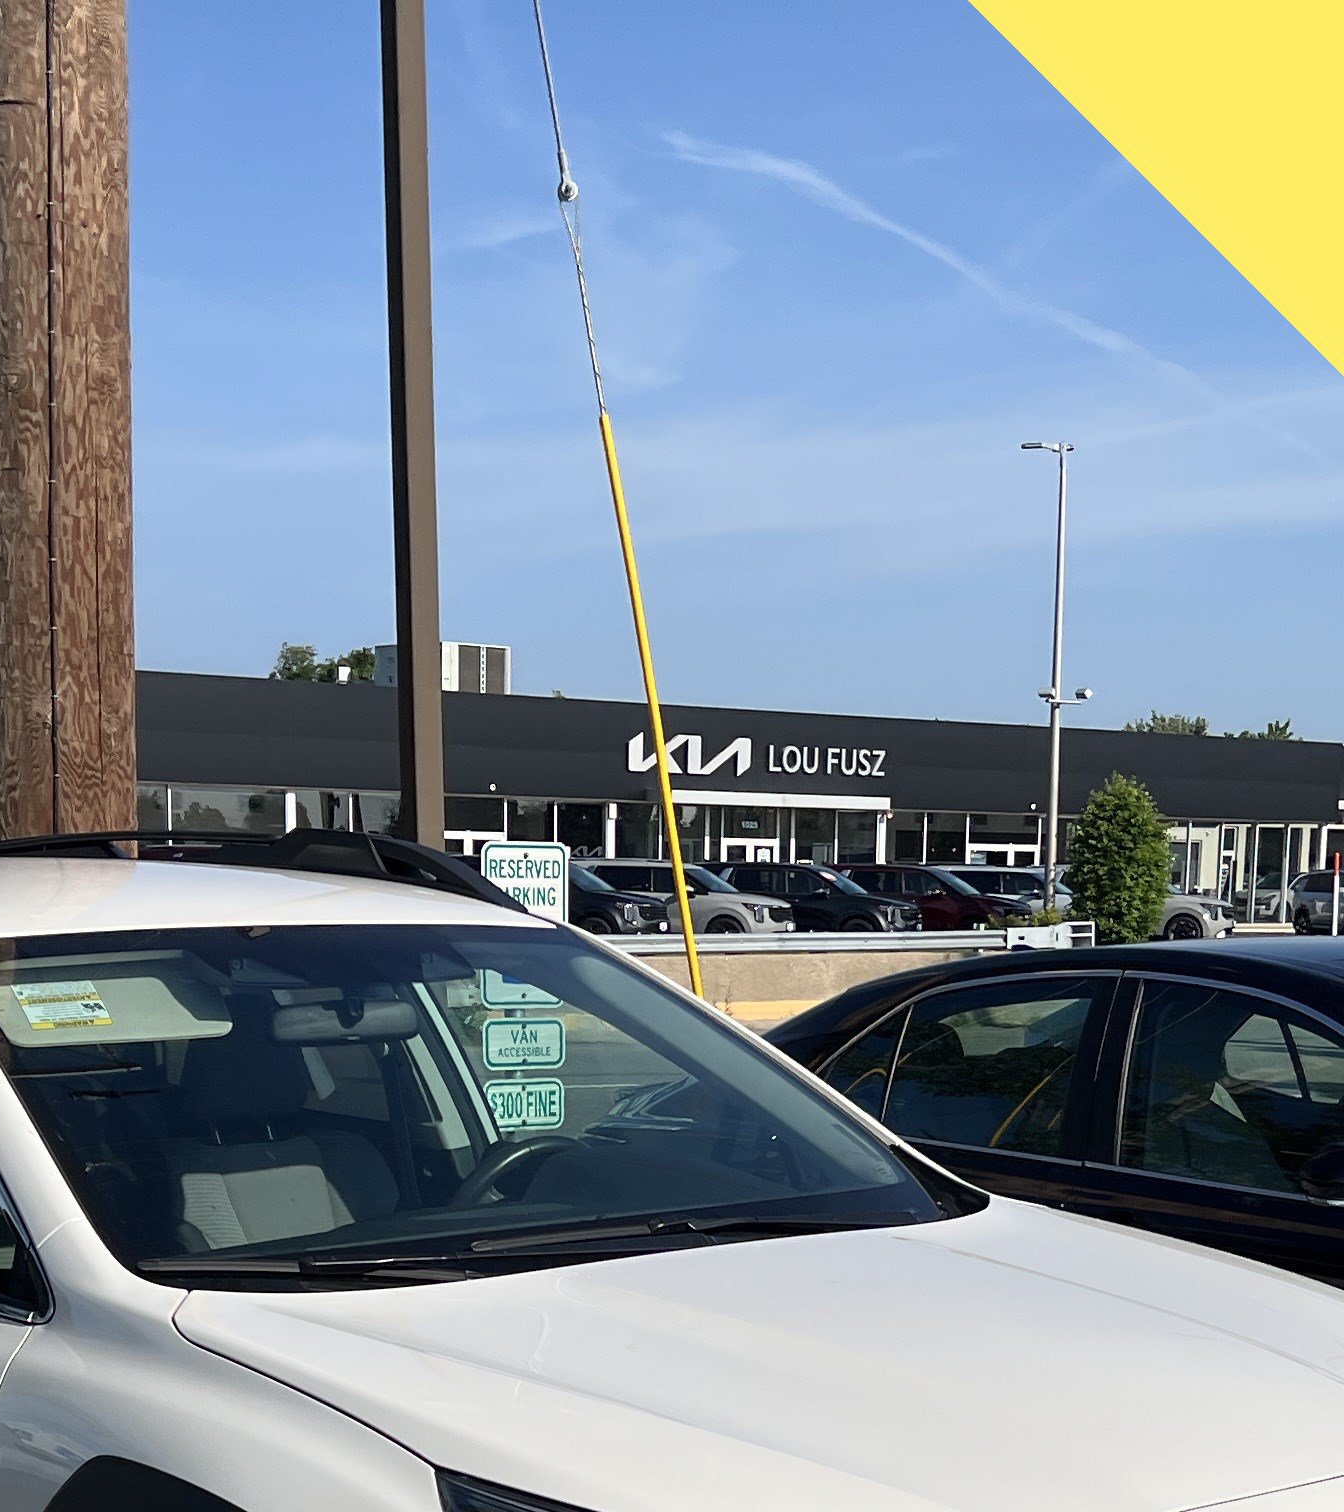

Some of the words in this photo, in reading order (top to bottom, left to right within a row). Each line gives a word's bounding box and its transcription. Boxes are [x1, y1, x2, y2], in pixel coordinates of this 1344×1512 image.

[628, 731, 752, 777] KIA
[768, 744, 820, 774] LOU
[826, 747, 887, 777] FUSZ
[489, 859, 561, 879] RESERVED
[510, 1029, 538, 1044] VAN
[498, 1045, 552, 1058] ACCESSIBLE
[490, 1092, 523, 1119] $300
[526, 1090, 557, 1118] FINE
